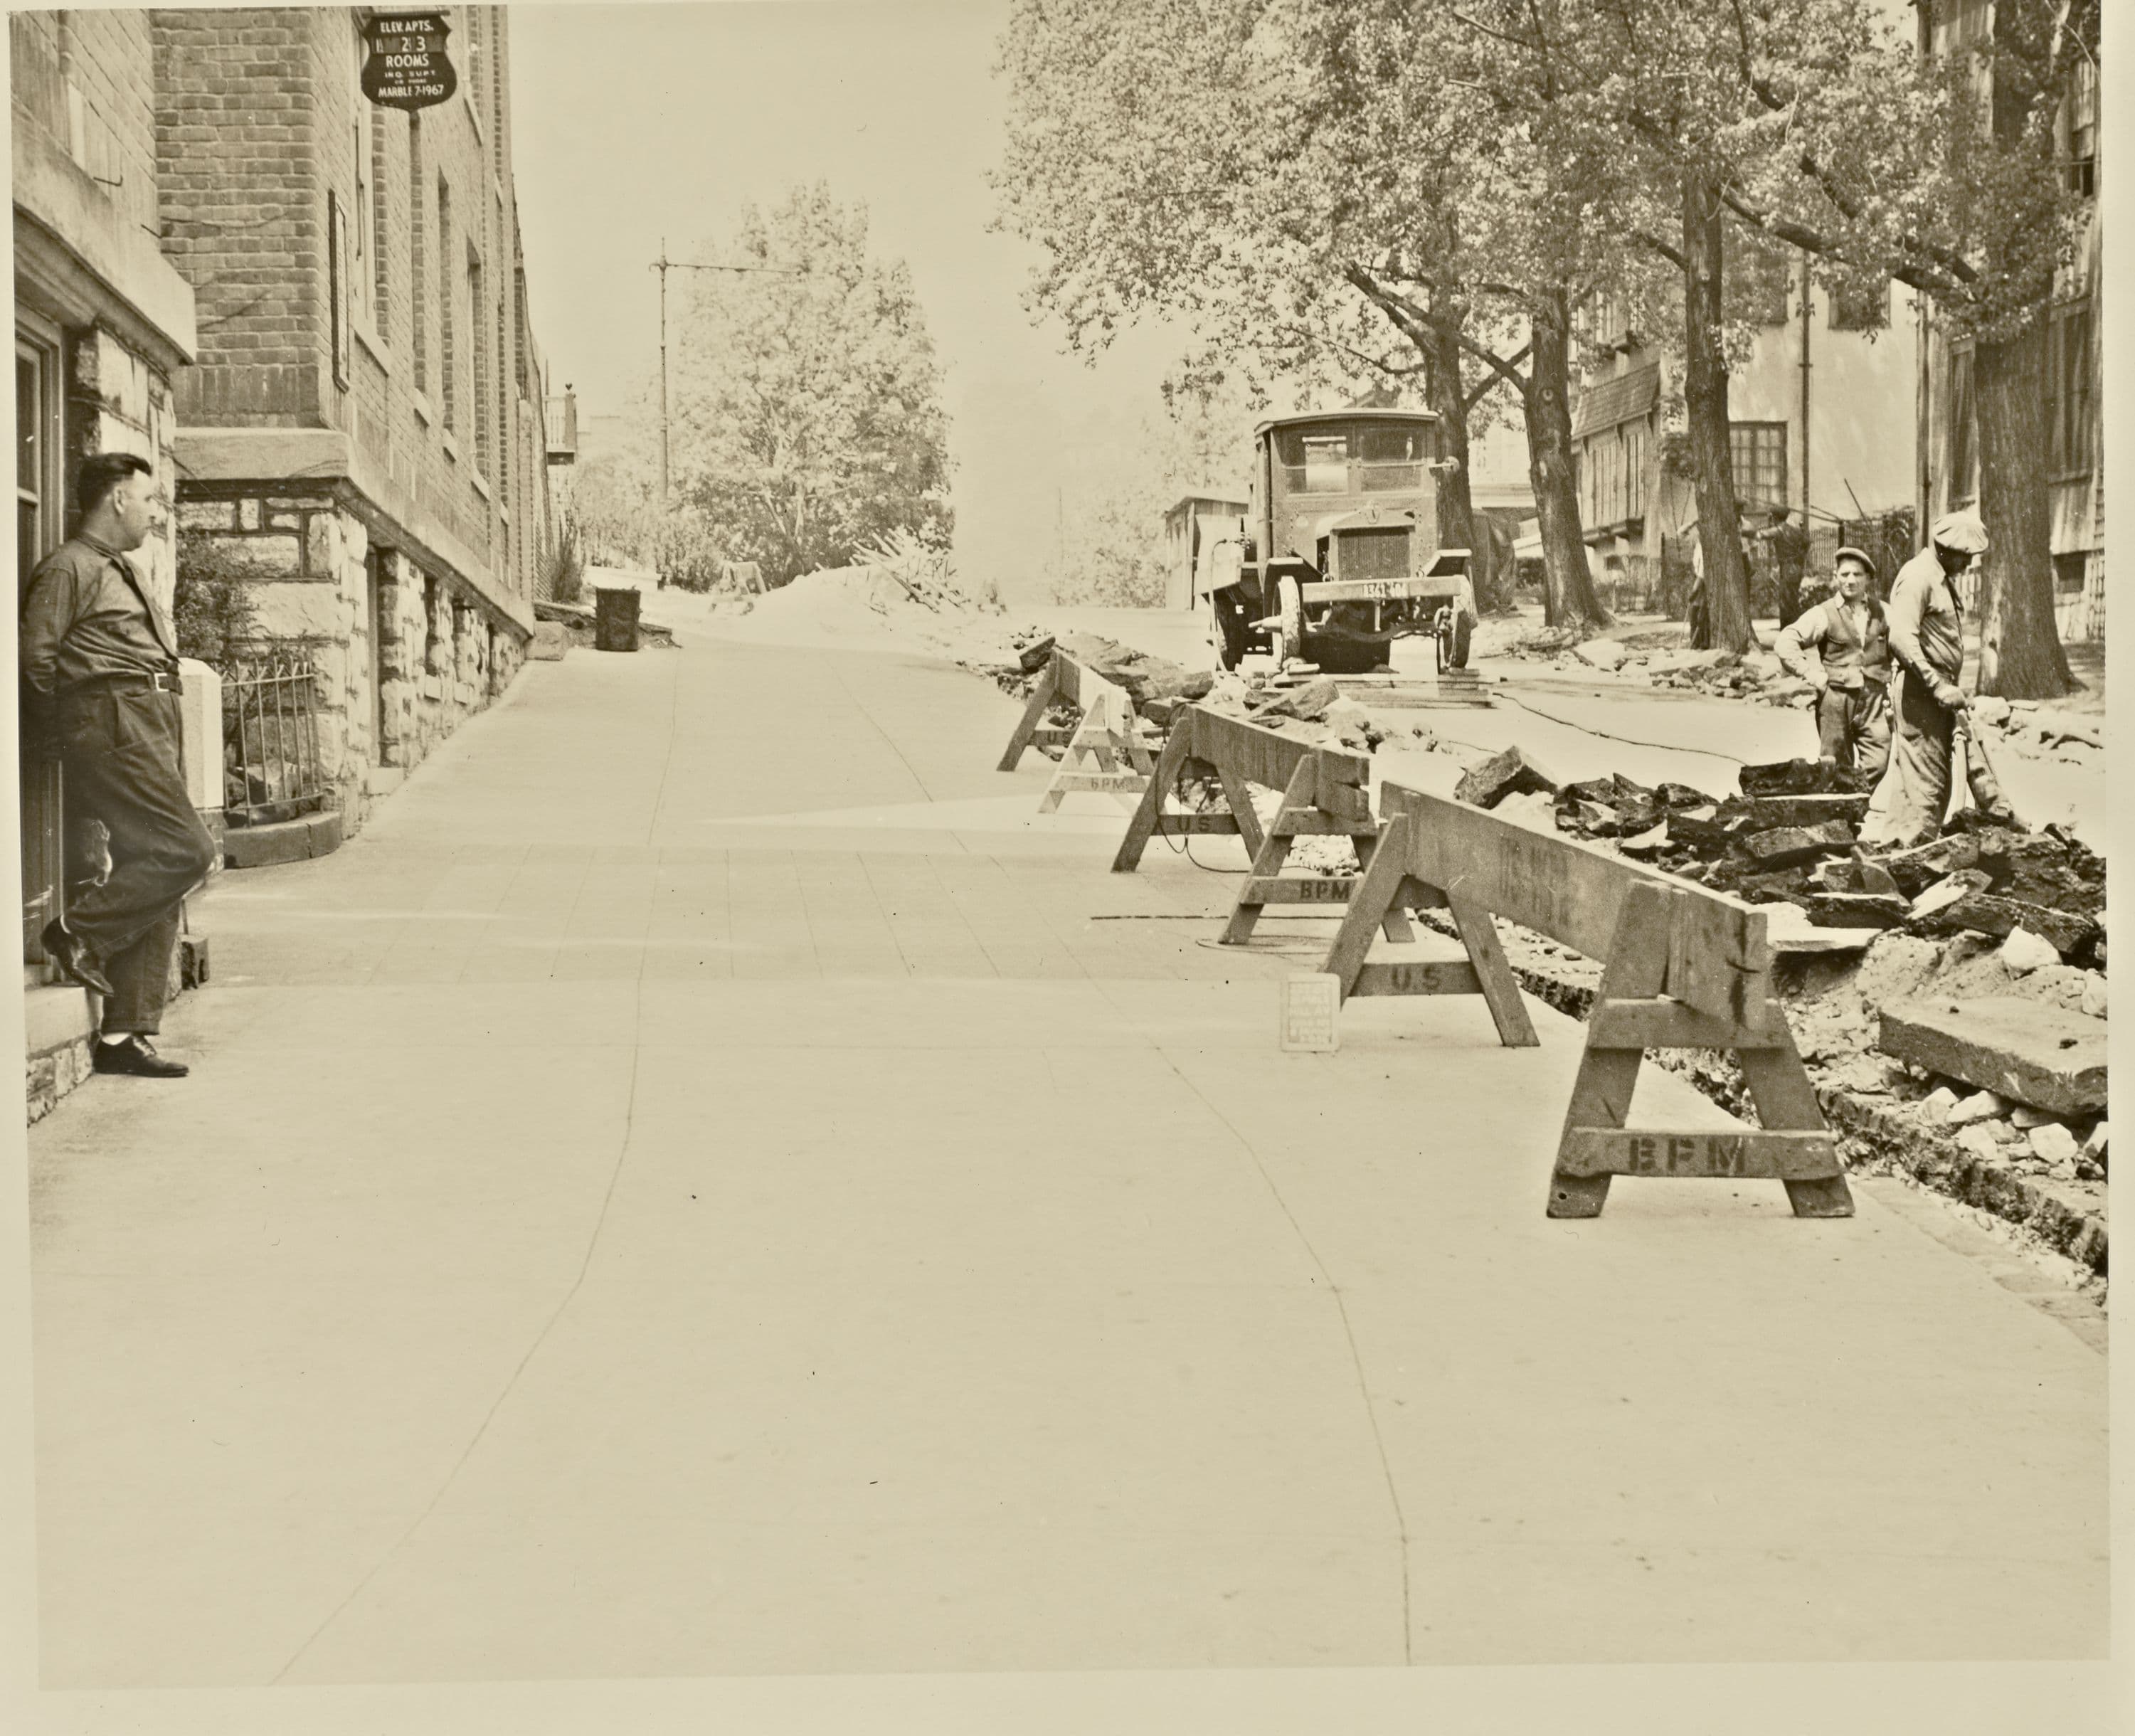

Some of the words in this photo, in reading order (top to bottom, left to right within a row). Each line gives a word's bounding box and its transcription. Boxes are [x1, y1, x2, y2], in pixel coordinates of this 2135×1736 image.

[405, 20, 434, 32] APTS.
[416, 36, 426, 52] 3
[386, 54, 429, 68] ROOMS
[378, 86, 412, 97] MARBLE
[415, 84, 445, 97] 7-1967
[1300, 880, 1350, 899] BPM
[1391, 966, 1441, 991] US
[1628, 1138, 1745, 1173] BPM
